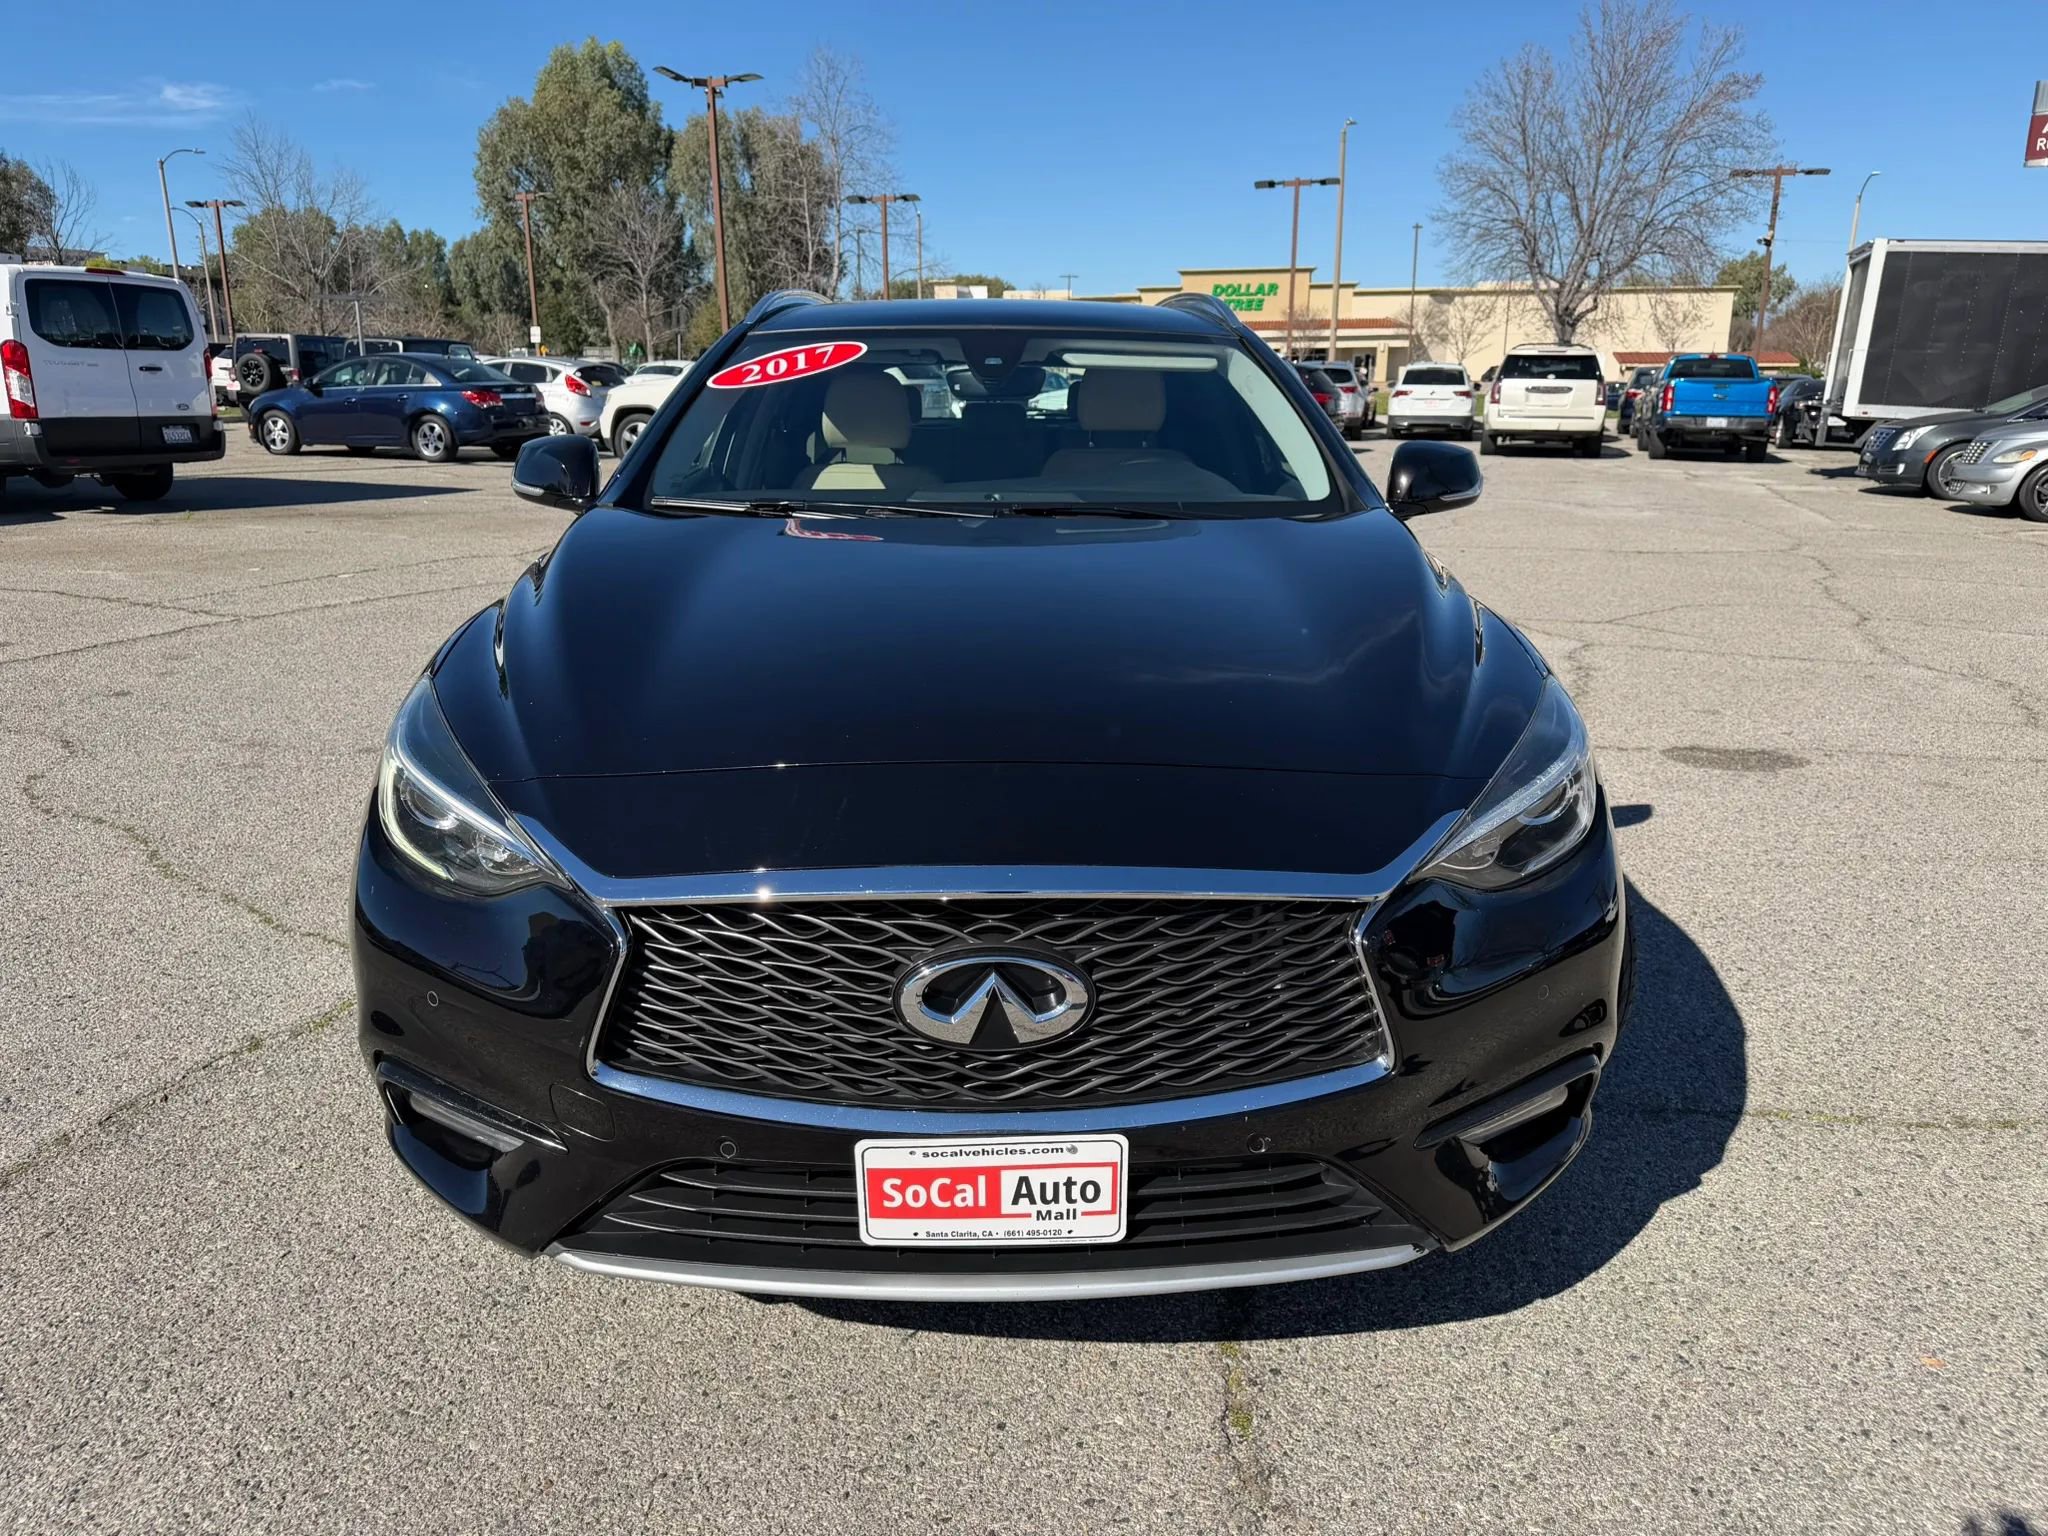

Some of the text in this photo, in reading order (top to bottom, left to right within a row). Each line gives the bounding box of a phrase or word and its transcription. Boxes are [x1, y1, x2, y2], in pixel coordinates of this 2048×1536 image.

[1212, 283, 1279, 297] DOLLAR
[1224, 298, 1265, 311] TREE
[741, 344, 835, 383] 2017
[922, 1146, 1064, 1159] socalvehicles.com
[882, 1174, 1102, 1209] SoCal Auto
[1036, 1209, 1077, 1221] Mall
[925, 1228, 1063, 1239] Santa Clarita, CA (661) 495-0120
